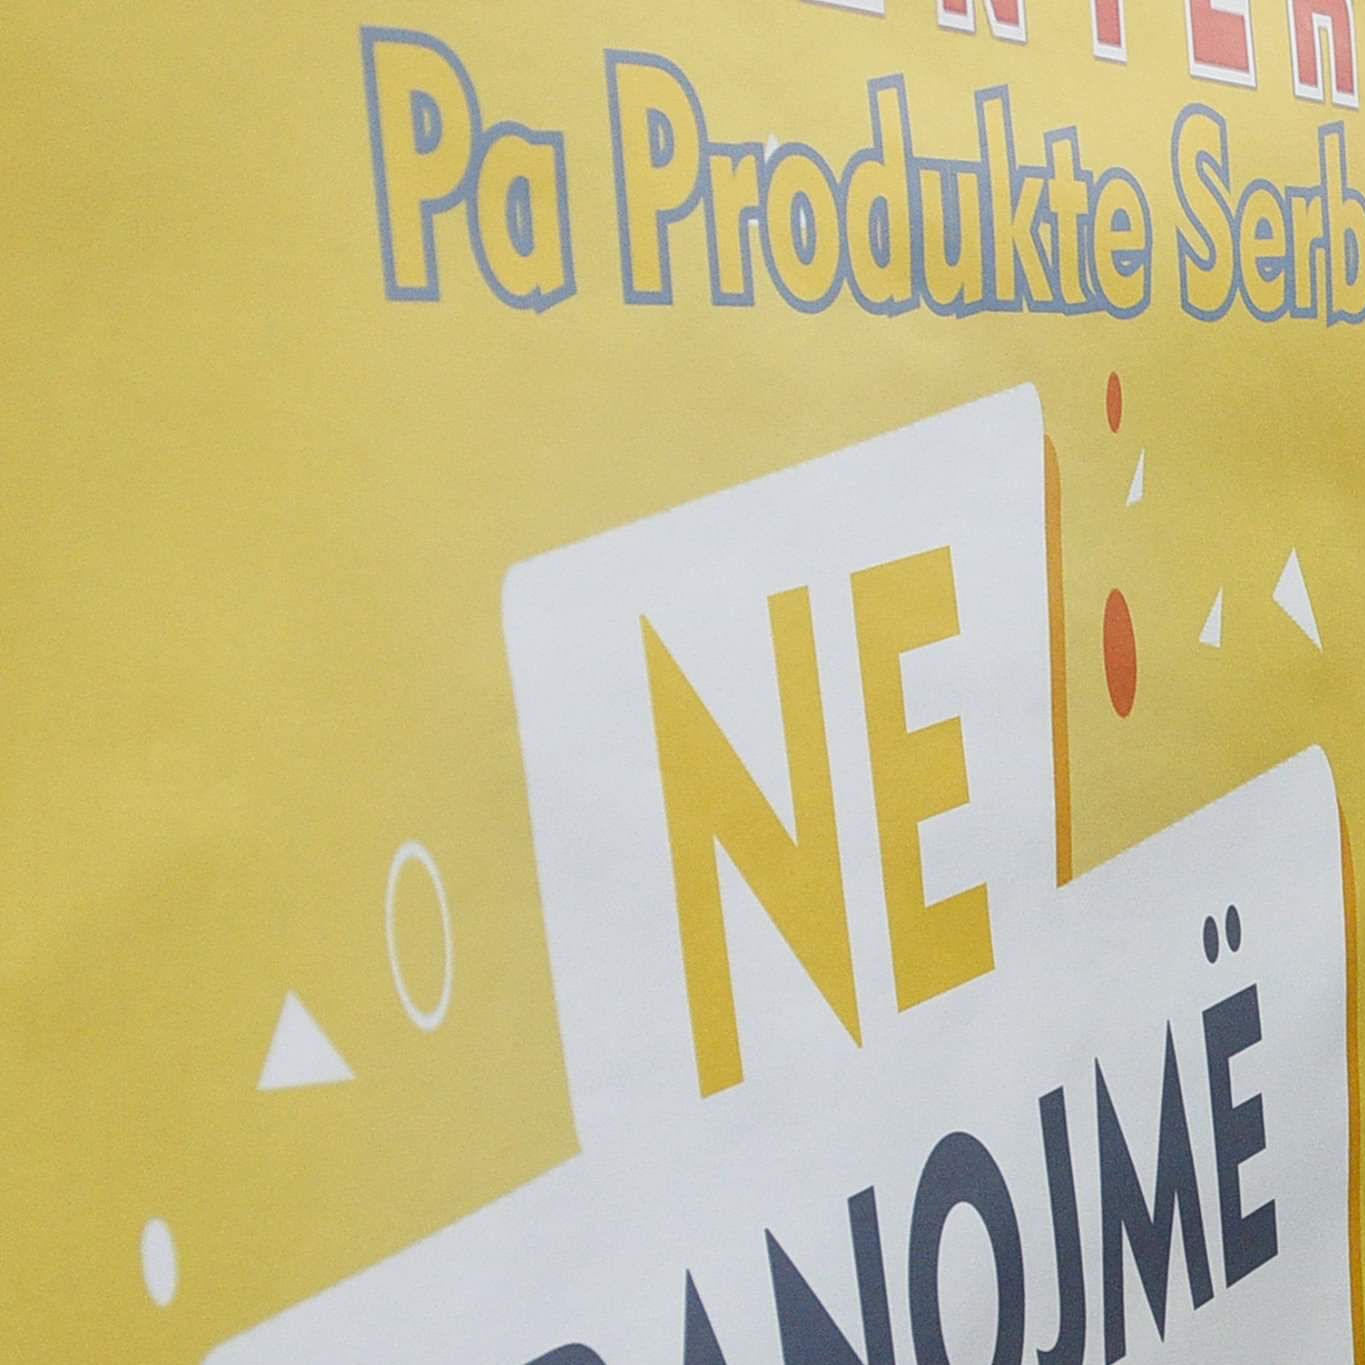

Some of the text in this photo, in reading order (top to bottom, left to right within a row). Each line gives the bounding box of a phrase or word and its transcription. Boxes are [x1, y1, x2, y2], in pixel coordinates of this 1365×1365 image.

[360, 26, 577, 314] Pa
[604, 49, 1152, 319] Produkte
[640, 546, 1000, 1094] NE
